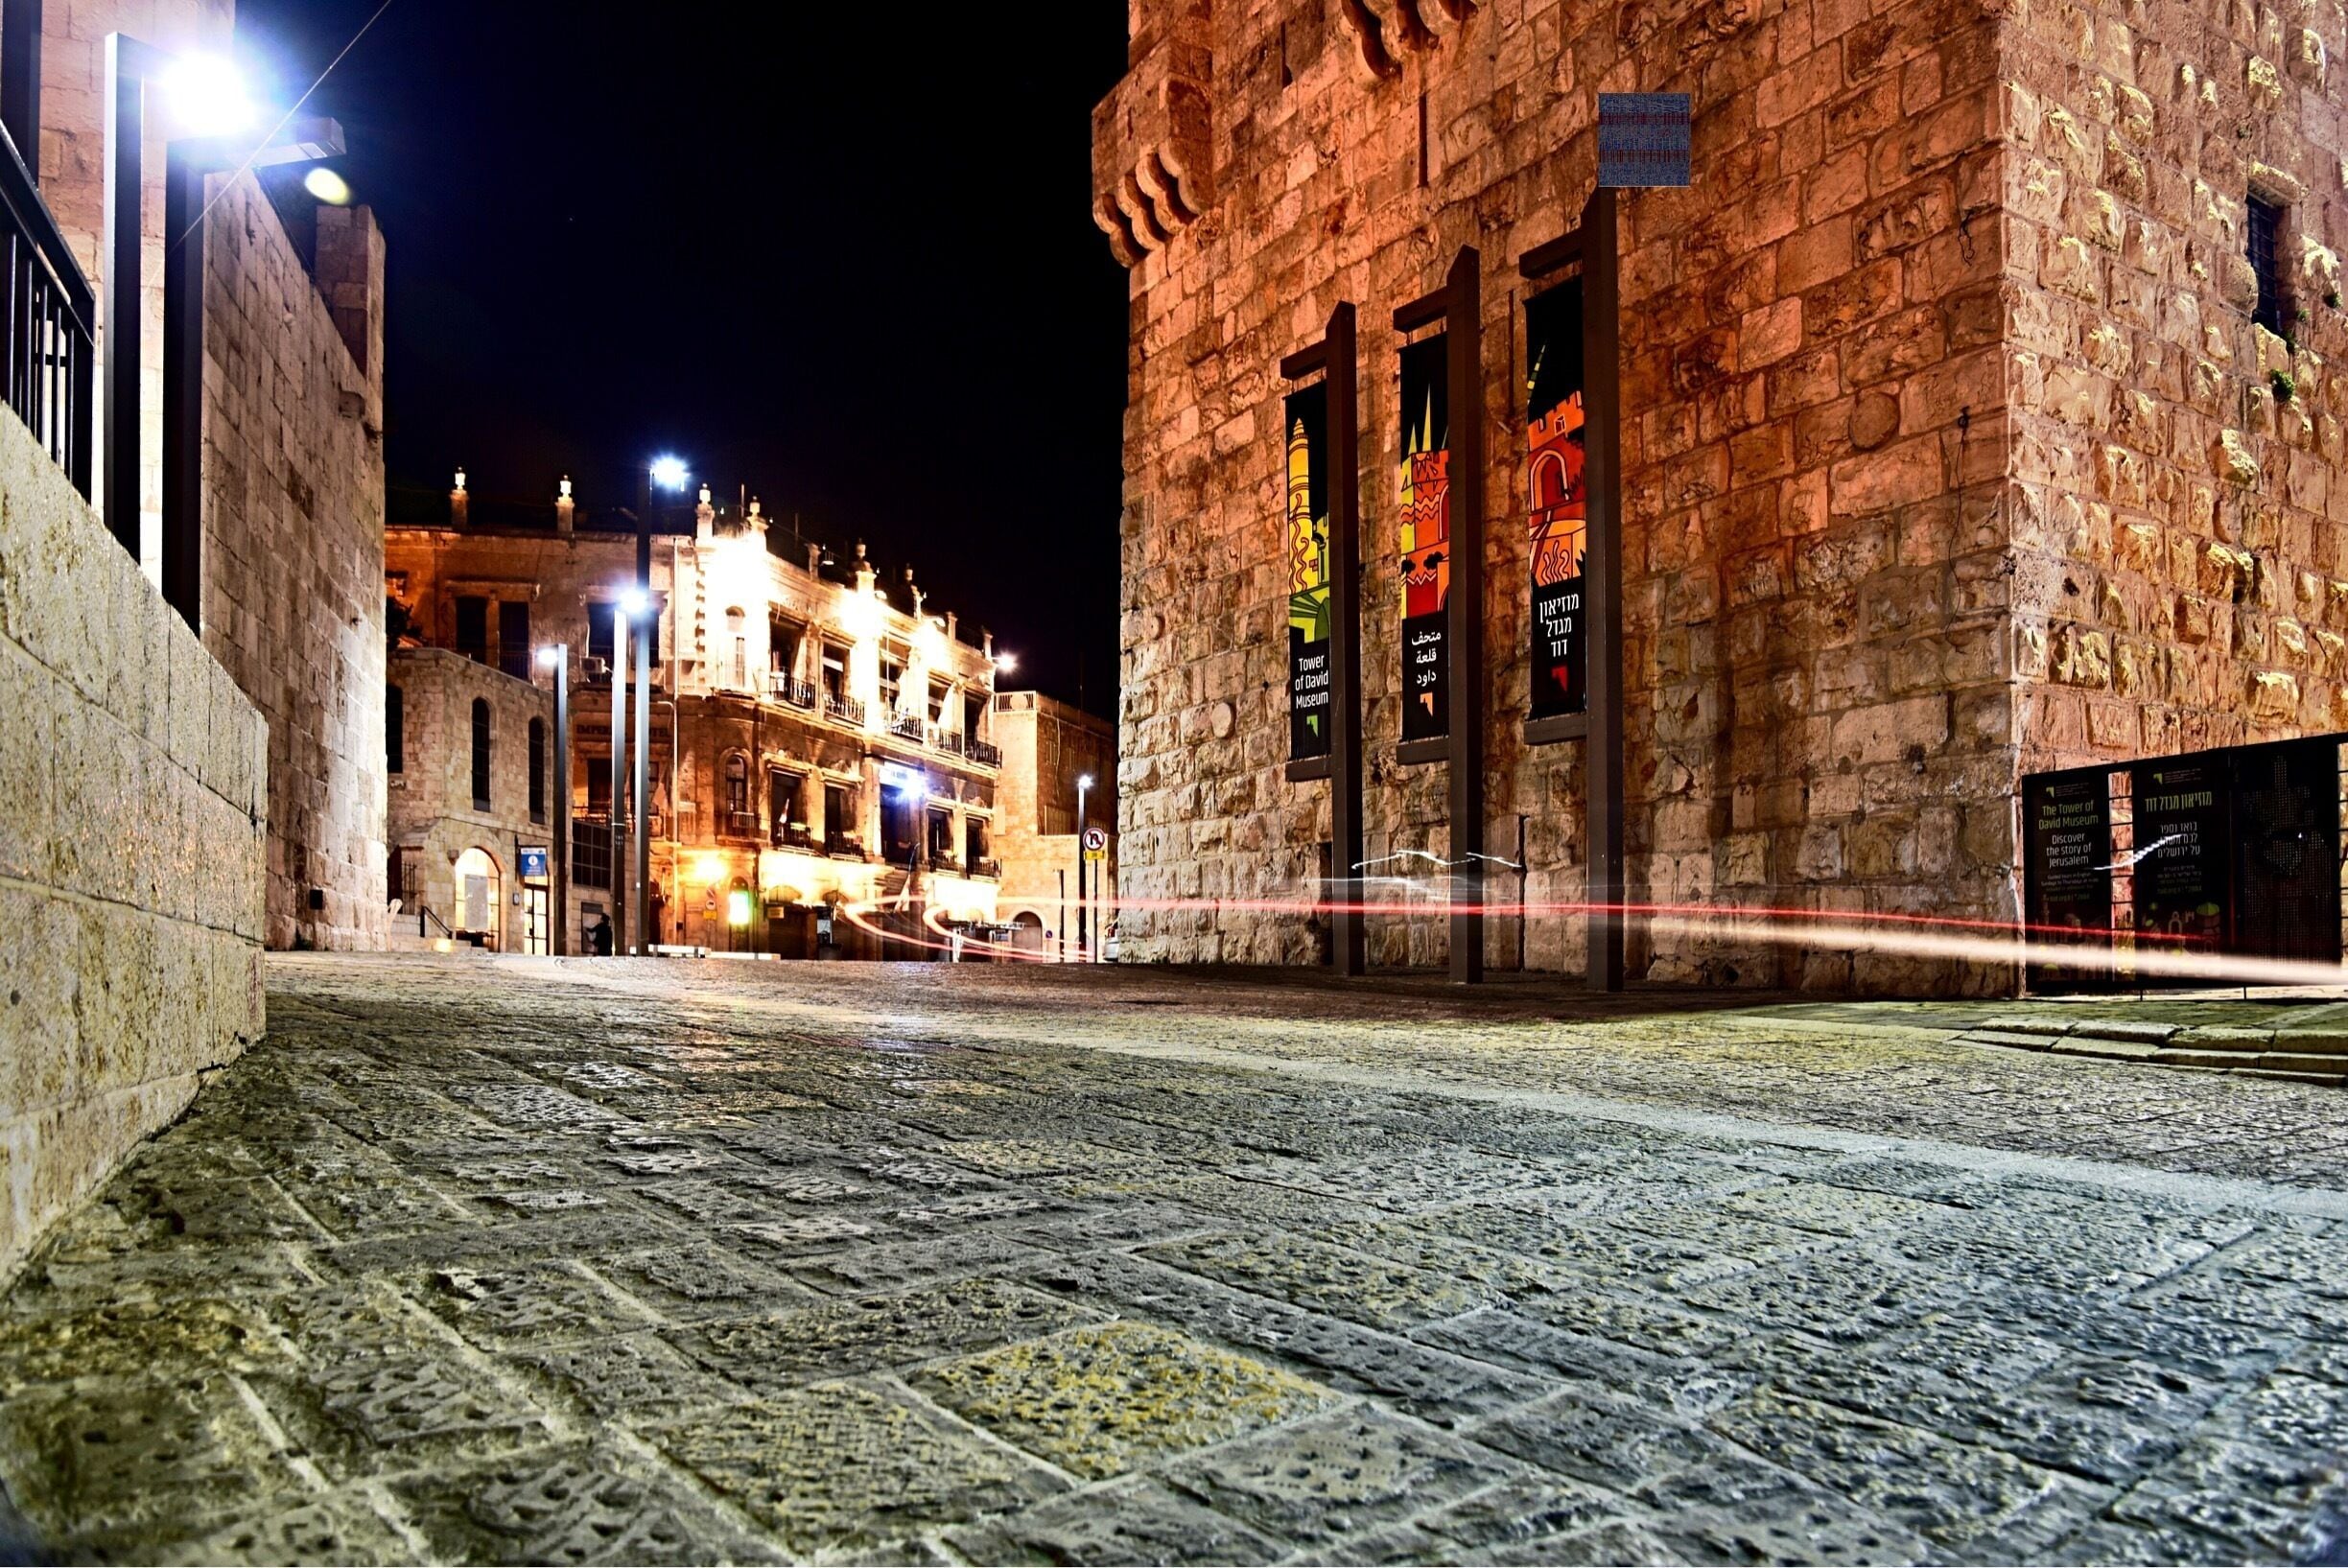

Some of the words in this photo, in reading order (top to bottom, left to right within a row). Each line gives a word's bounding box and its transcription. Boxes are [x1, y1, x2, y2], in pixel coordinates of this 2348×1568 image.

[1538, 592, 1580, 624] מוזיאון
[1545, 616, 1572, 638] מגדל
[1411, 630, 1442, 647] متحف
[1415, 647, 1438, 665] قلعة
[1550, 639, 1568, 658] דוד
[1298, 654, 1325, 672] Tower
[1295, 675, 1304, 691] of
[1305, 670, 1329, 689] David
[1416, 668, 1437, 687] داود
[1296, 690, 1329, 710] Museum
[2042, 805, 2057, 816] The
[2059, 802, 2083, 815] Tower
[2084, 799, 2094, 812] of
[2145, 797, 2157, 813] דוד
[2160, 795, 2180, 812] מגדל
[2181, 790, 2213, 810] מוזיאון
[2038, 817, 2061, 831] David
[2062, 813, 2099, 828] Museum
[2180, 821, 2197, 832] בואו
[2052, 832, 2085, 845] Discover
[2046, 846, 2059, 857] the
[2061, 843, 2081, 856] story
[2083, 841, 2092, 853] of
[2157, 845, 2188, 858] ירושלים
[2049, 854, 2089, 870] Jerusalem
